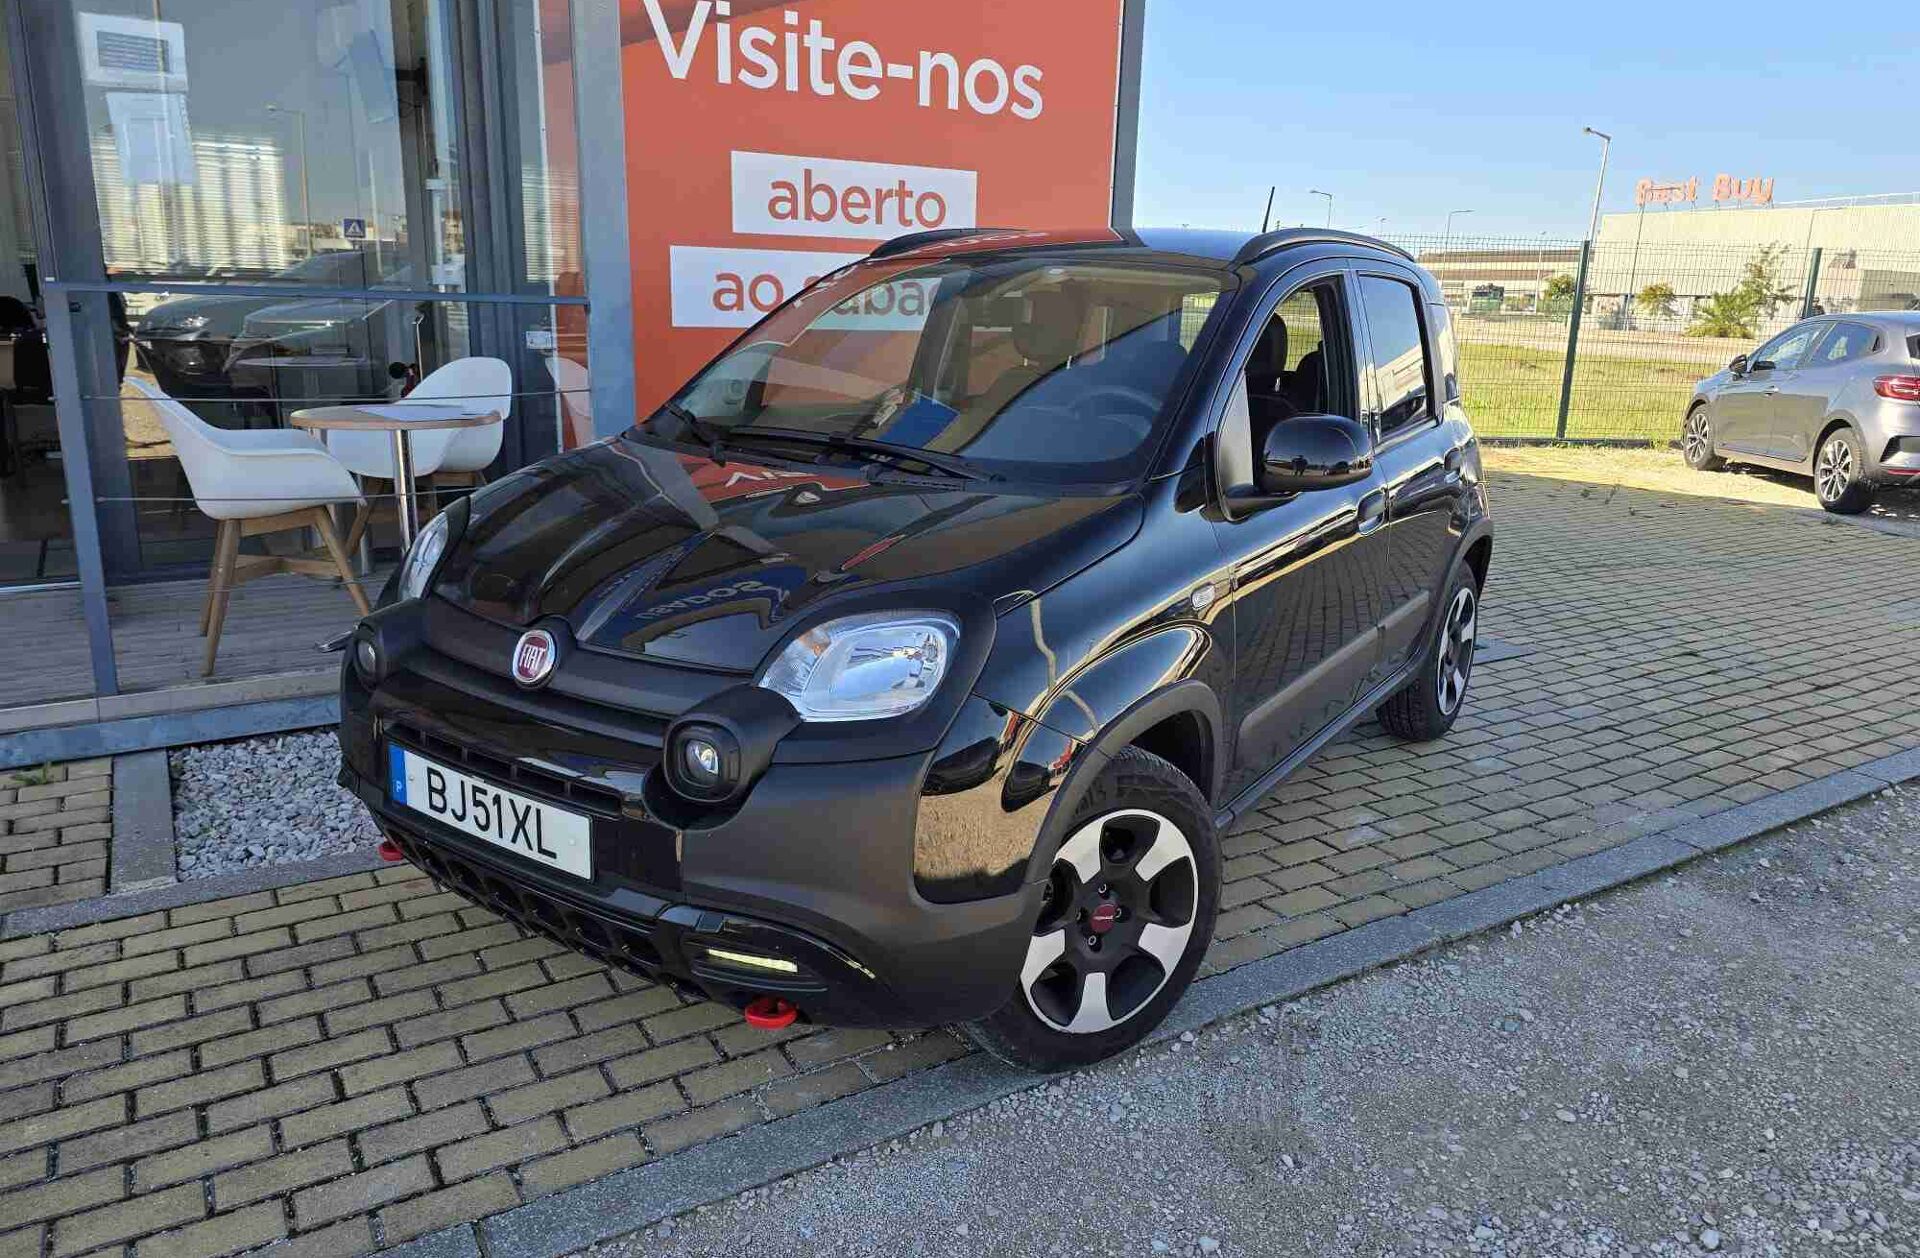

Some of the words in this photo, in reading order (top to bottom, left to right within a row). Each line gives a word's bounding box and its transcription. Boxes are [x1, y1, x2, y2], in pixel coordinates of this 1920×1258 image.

[642, 0, 1044, 121] Visite-nos
[767, 169, 947, 229] aberto
[711, 271, 785, 313] ao
[519, 643, 547, 671] FIAT
[426, 766, 557, 860] BJ51XL
